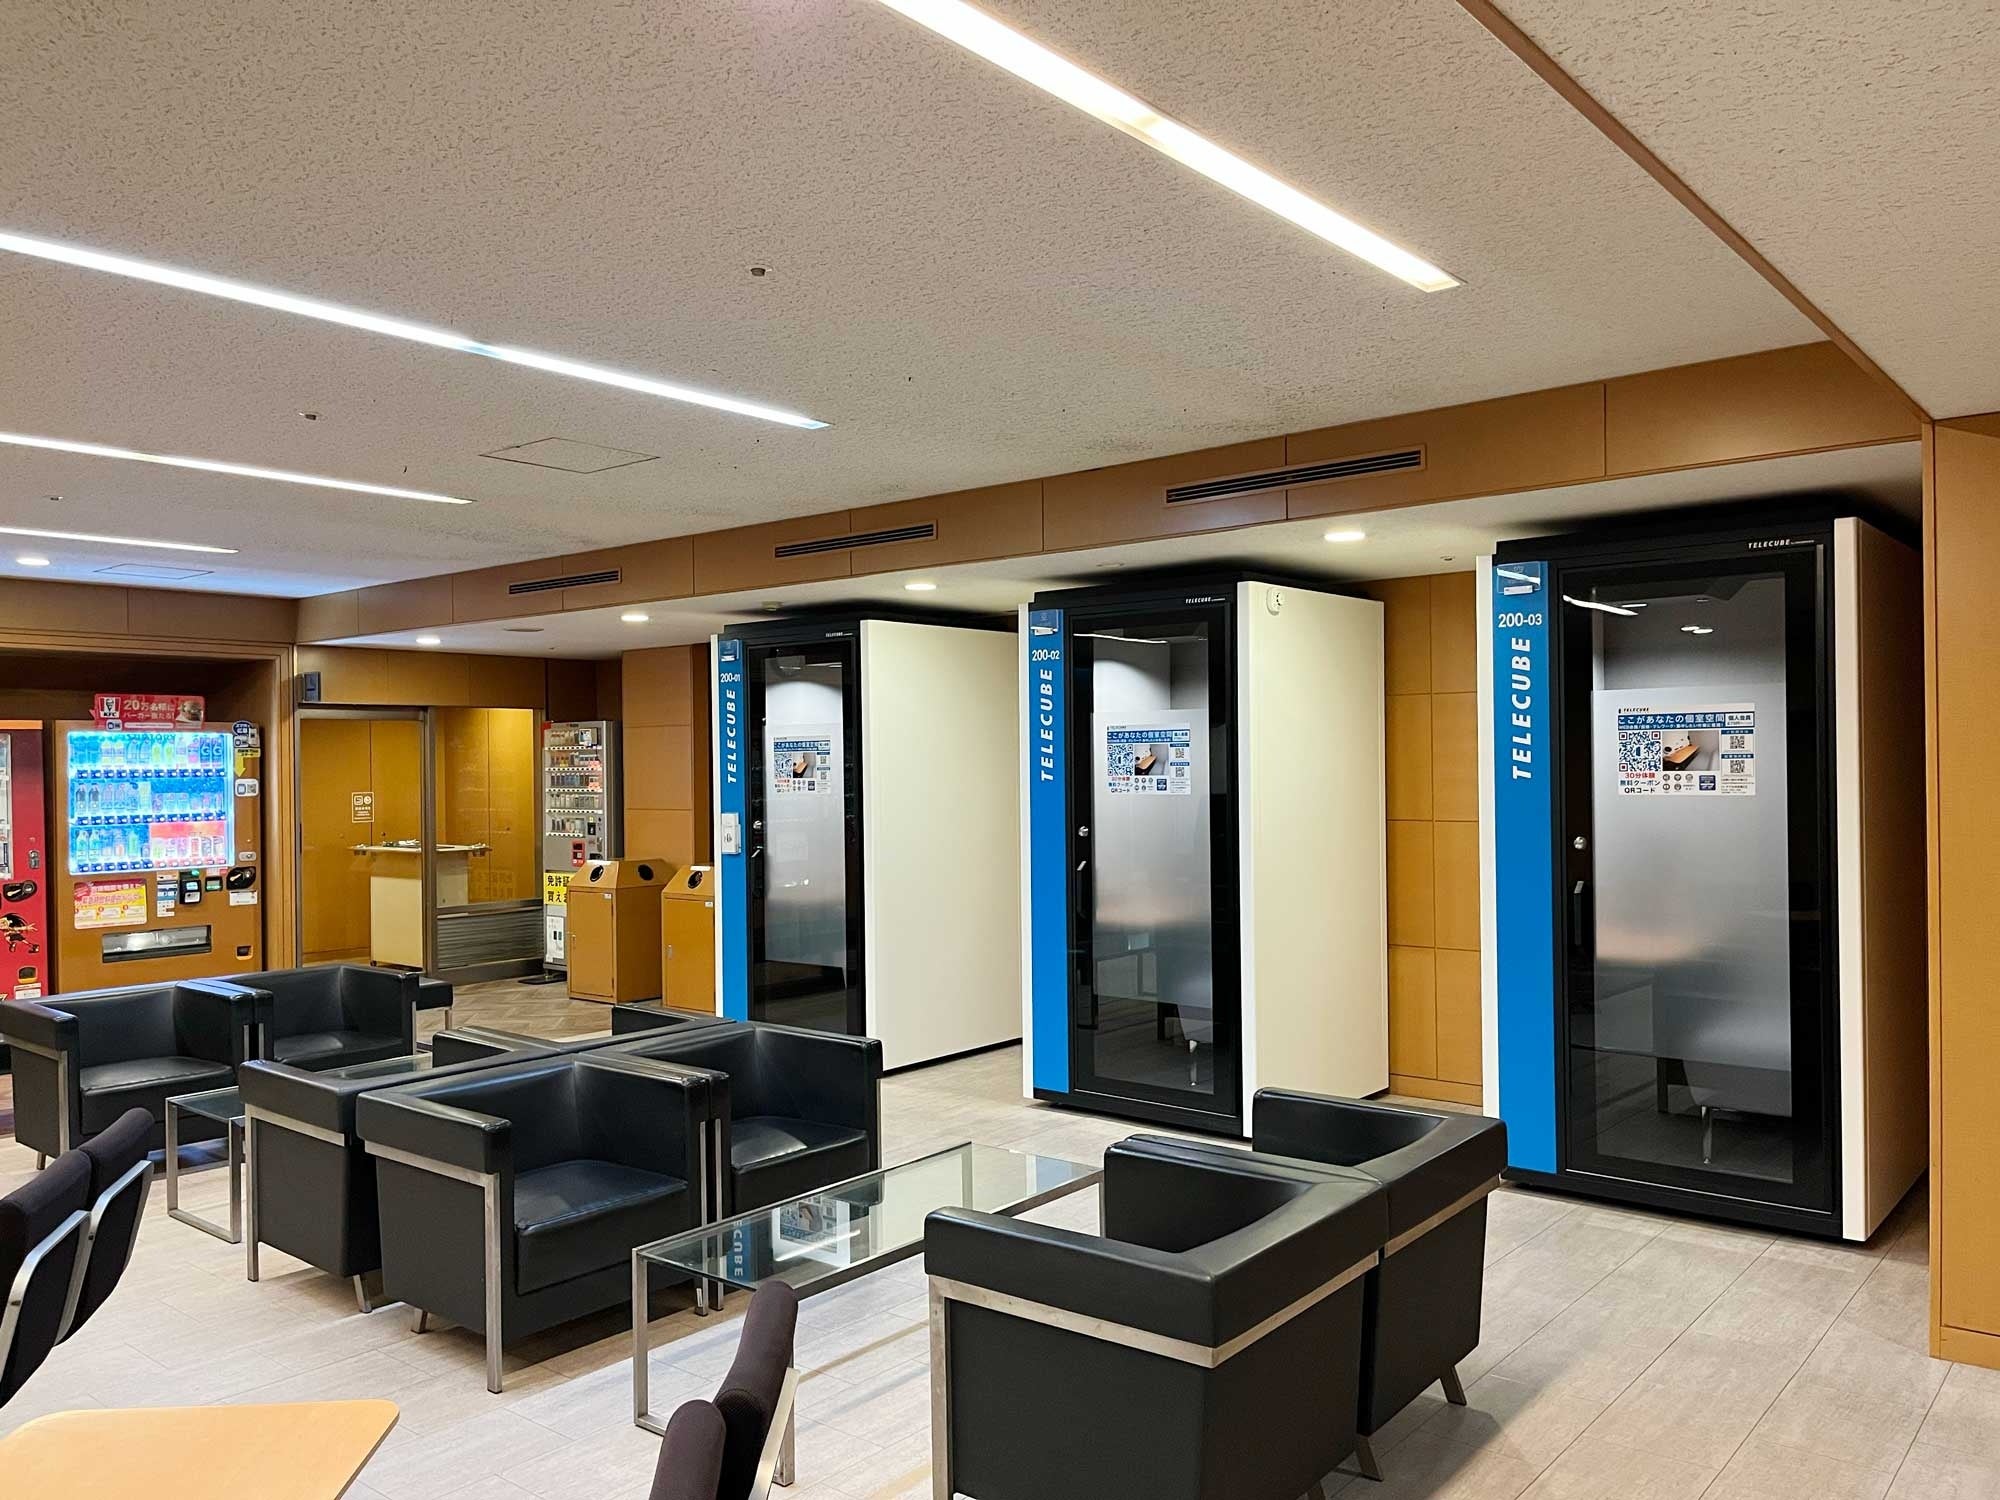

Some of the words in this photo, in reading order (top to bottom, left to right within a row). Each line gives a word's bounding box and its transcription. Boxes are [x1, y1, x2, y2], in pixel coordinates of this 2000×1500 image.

[1748, 539, 1791, 549] TELECUBE
[1498, 612, 1542, 628] 200-03
[1032, 649, 1060, 661] 200-02
[720, 672, 741, 682] 200-01
[1511, 637, 1532, 780] TELECUBE
[1040, 669, 1054, 781] TELECUBE
[1618, 713, 1725, 724] ここがあなたの個室空間
[726, 689, 737, 784] TELECUBE
